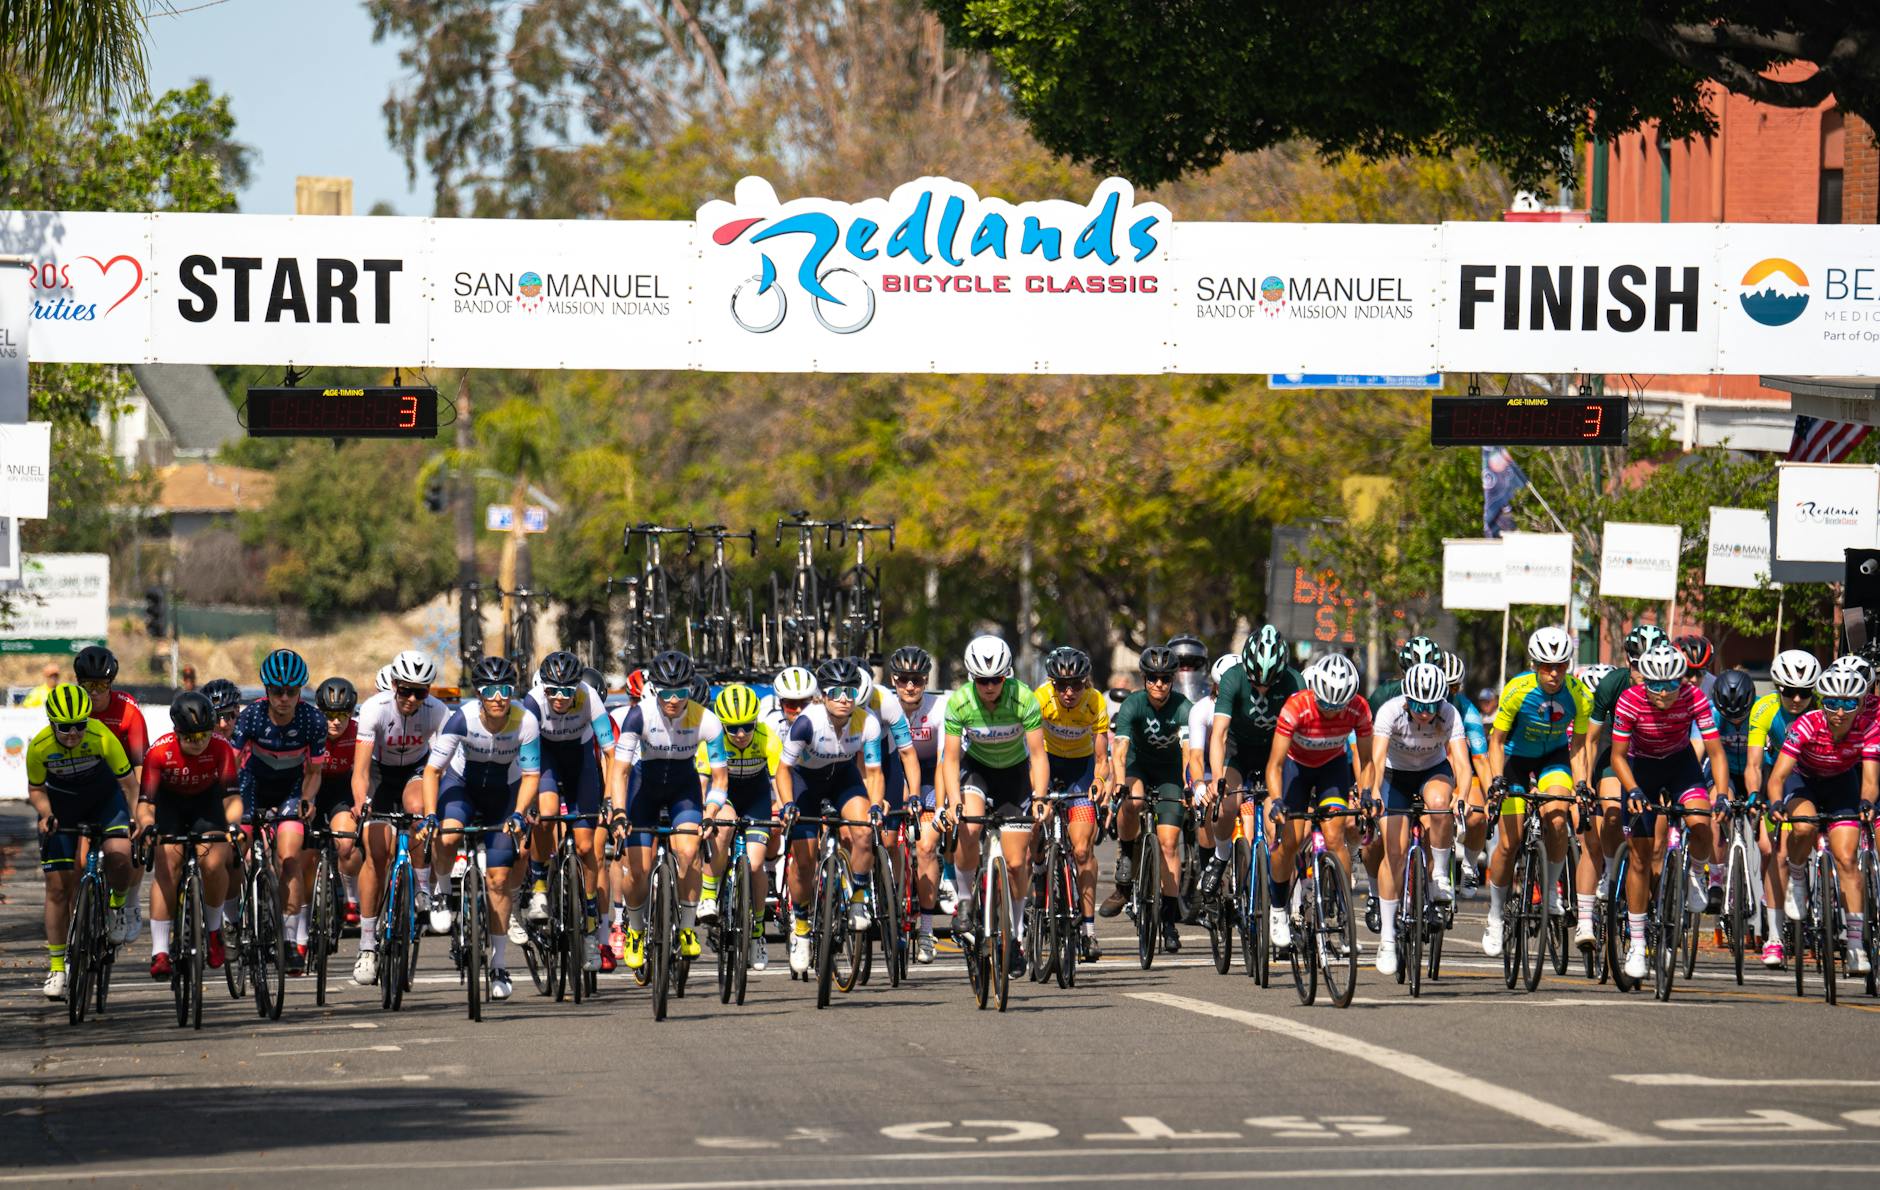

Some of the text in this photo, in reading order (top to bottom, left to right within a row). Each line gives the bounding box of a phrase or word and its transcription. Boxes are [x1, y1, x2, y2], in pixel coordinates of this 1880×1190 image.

[750, 191, 1159, 306] Redlands
[177, 254, 403, 324] START
[453, 271, 670, 299] SAN MANUEL
[882, 274, 1159, 294] BICYCLE CLASSIC
[1196, 276, 1412, 302] SAN MANUEL
[1826, 268, 1880, 301] BE
[454, 300, 670, 316] BAND OF MISSION INDIANS
[1197, 304, 1413, 319] BAND OF MISSION INDIANS
[1458, 264, 1700, 333] FINISH
[1823, 330, 1880, 343] Part of Op
[399, 395, 418, 428] 3
[1583, 405, 1602, 437] 3
[386, 735, 423, 747] LUX
